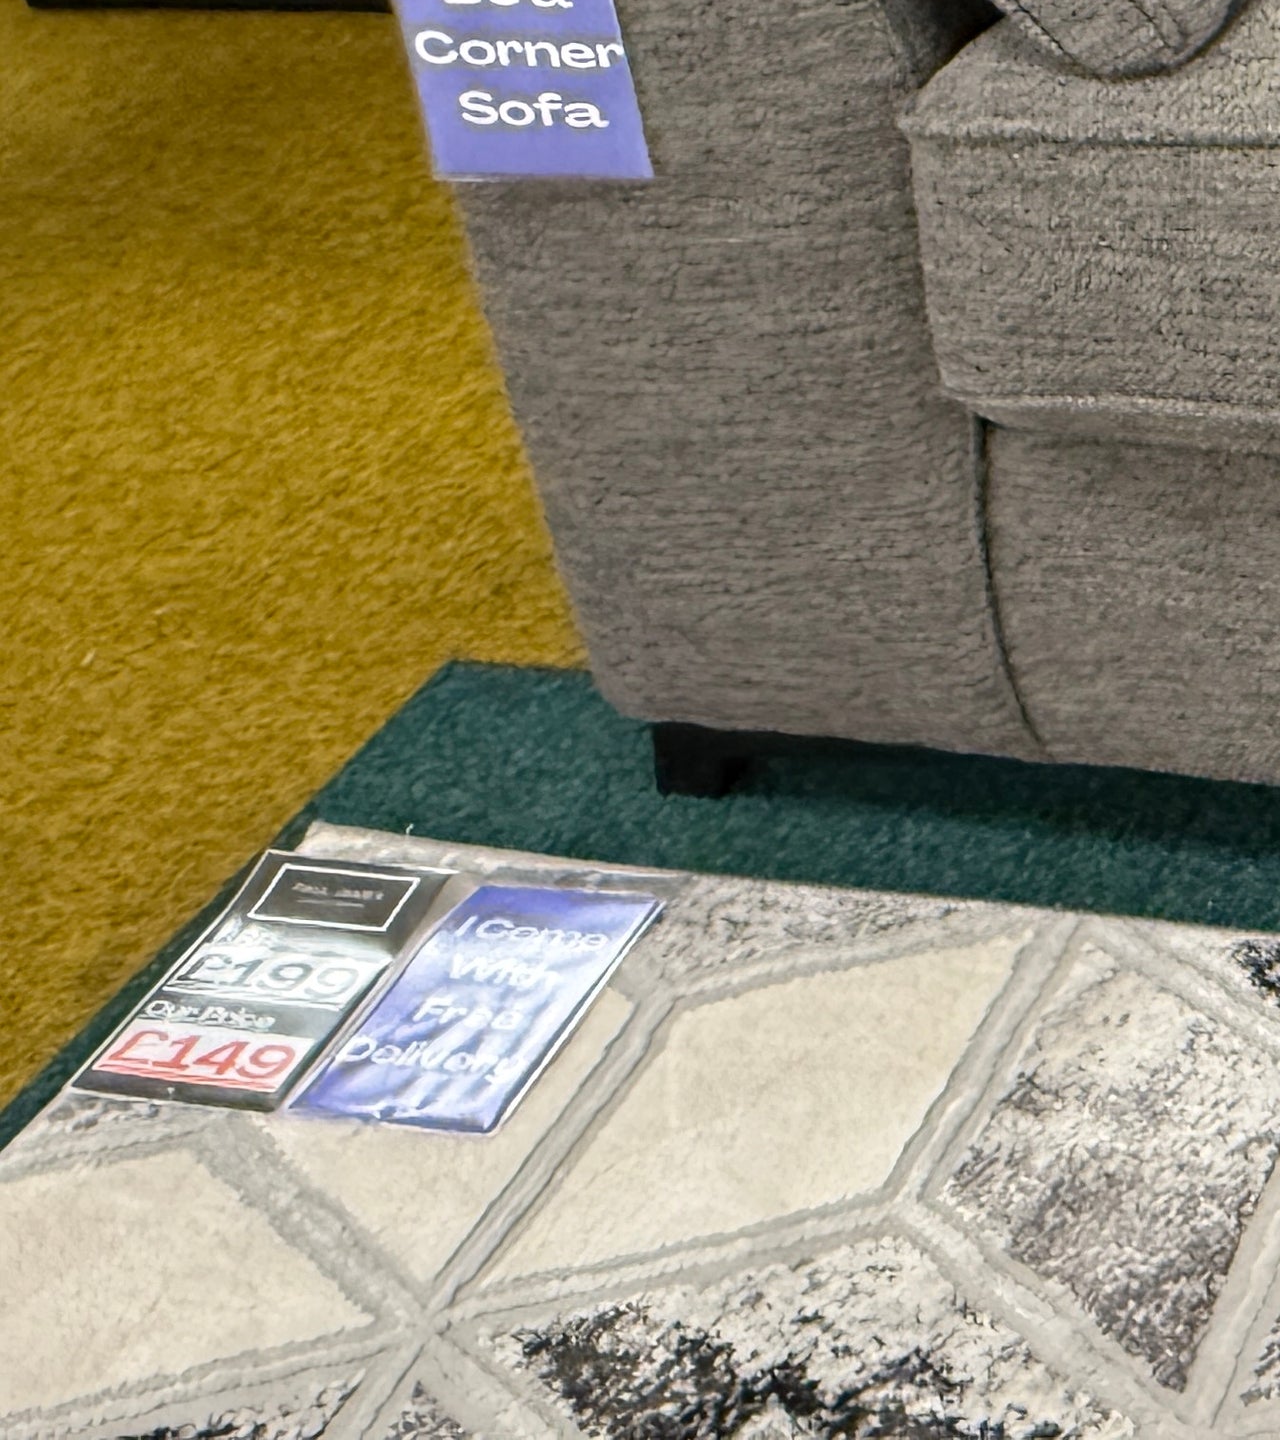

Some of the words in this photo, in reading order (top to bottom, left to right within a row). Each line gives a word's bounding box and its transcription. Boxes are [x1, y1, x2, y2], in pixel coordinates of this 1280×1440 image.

[414, 30, 625, 68] Corner
[458, 90, 610, 129] Sofa
[455, 915, 479, 937] I
[475, 919, 609, 948] Come
[172, 953, 361, 1000] £199
[413, 996, 525, 1031] Free
[105, 1030, 297, 1079] £149
[342, 1035, 522, 1086] Delivery
